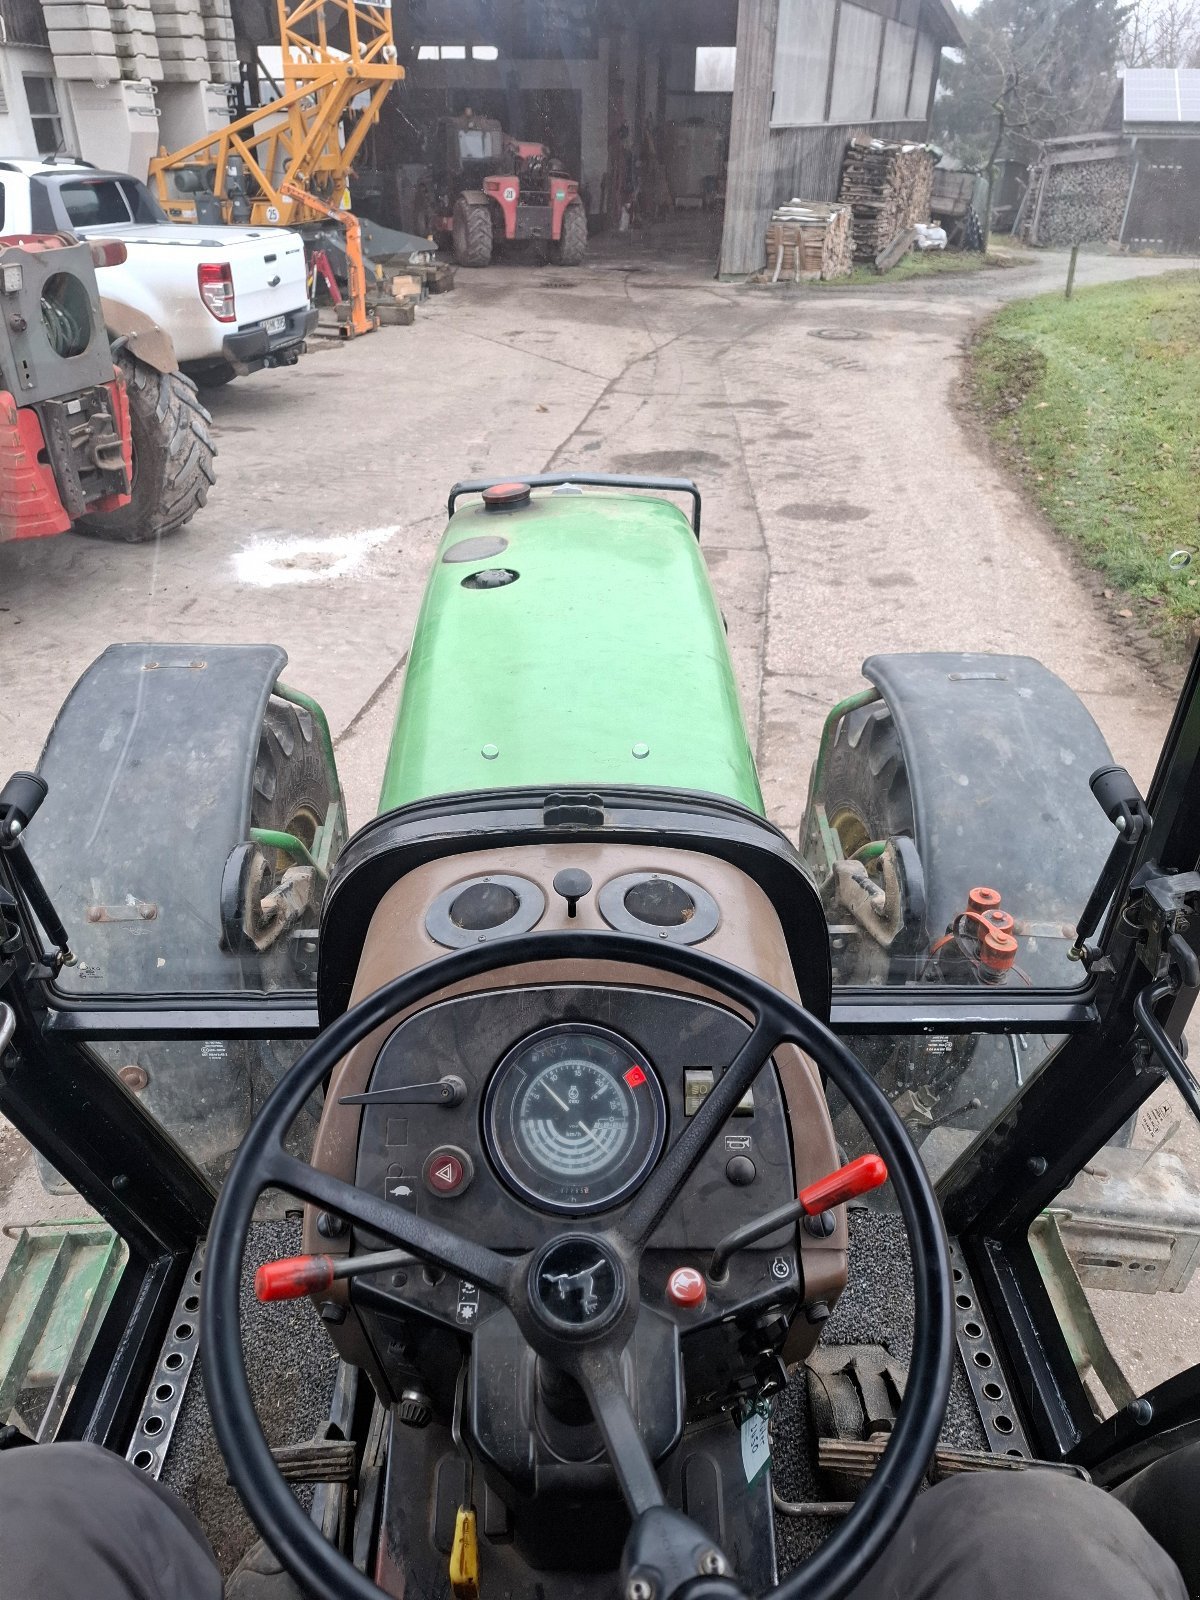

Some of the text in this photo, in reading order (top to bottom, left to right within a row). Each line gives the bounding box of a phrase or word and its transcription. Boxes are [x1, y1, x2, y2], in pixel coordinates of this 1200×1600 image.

[269, 208, 278, 220] 25
[574, 1069, 582, 1077] 15
[595, 1078, 604, 1088] 20
